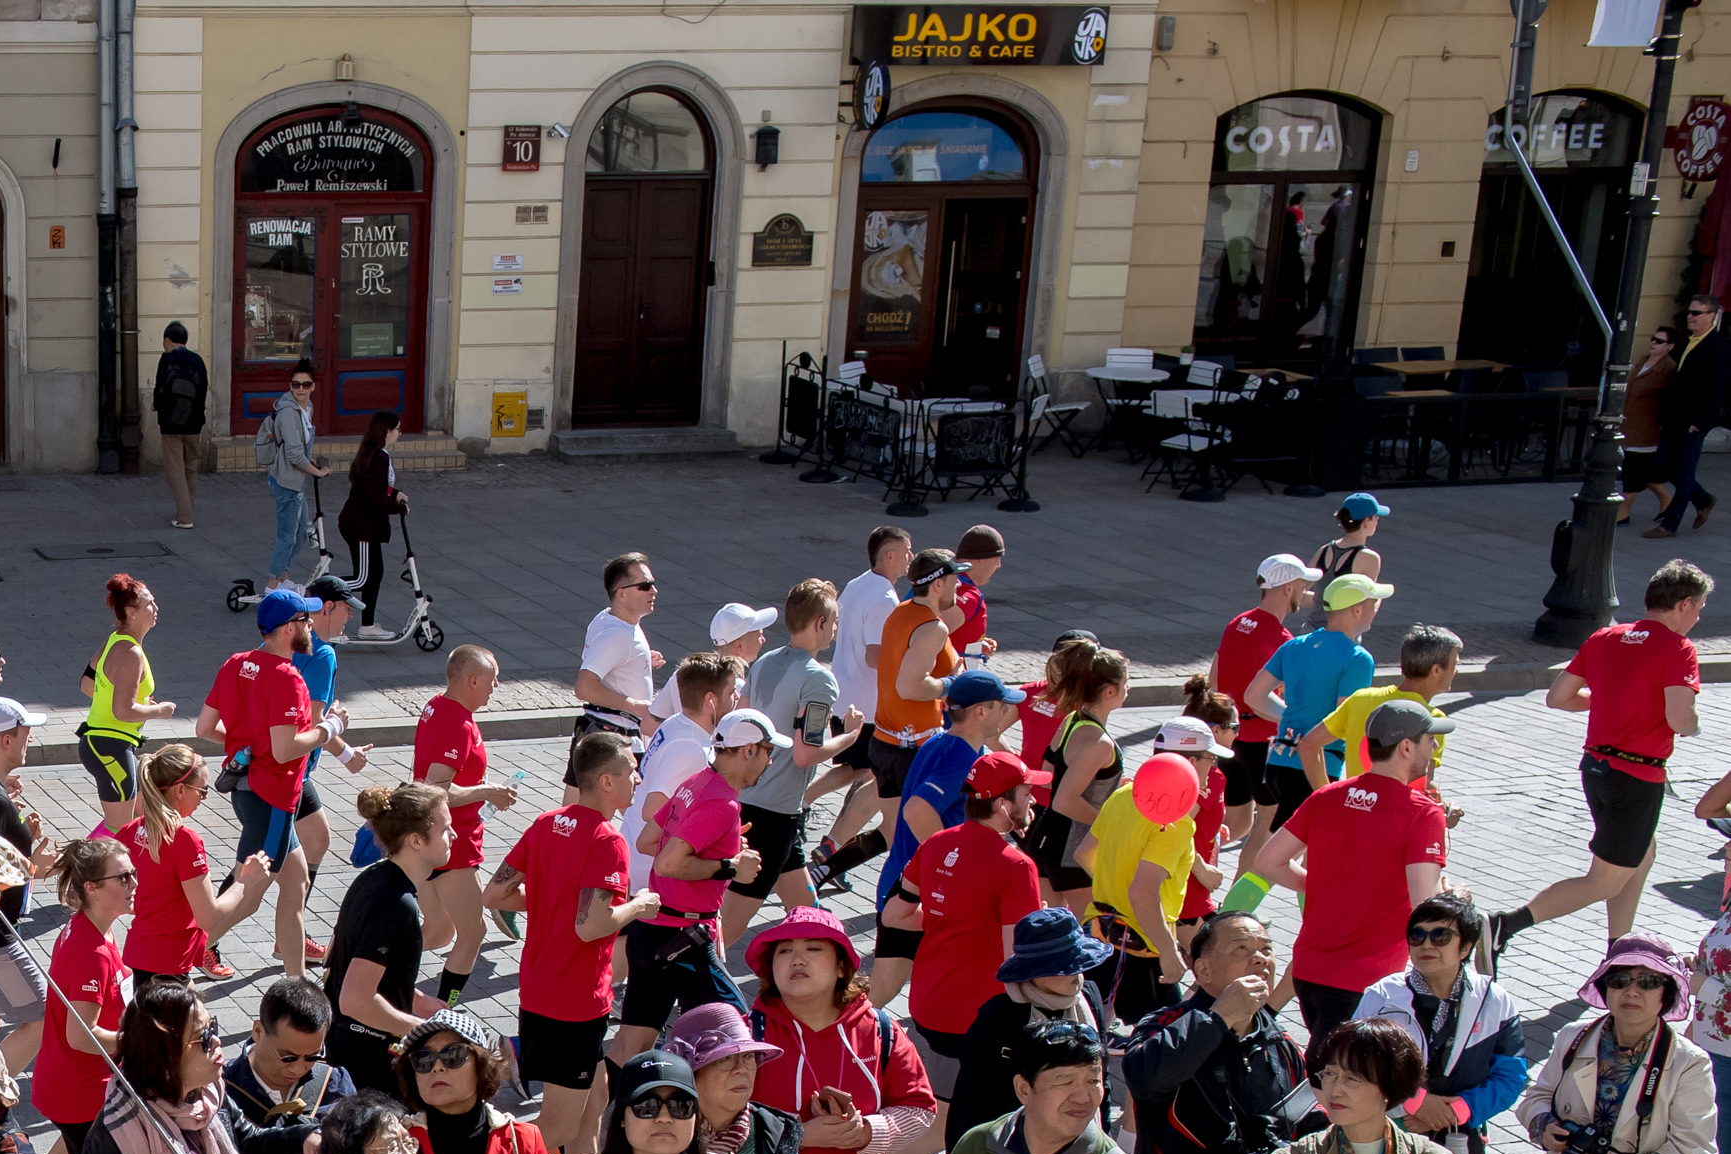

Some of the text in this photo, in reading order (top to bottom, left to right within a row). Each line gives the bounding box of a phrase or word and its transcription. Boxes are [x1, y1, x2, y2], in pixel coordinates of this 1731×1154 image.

[893, 12, 1038, 42] JAJKO
[891, 44, 1034, 58] BISTRO & CAFE
[1687, 104, 1726, 129] COSTA
[256, 120, 416, 158] PRACOWNIA ARTYCZNYCH
[287, 136, 386, 156] RAM STYLOWYCH
[1226, 124, 1336, 156] COSTA
[1484, 124, 1605, 150] COFFEE
[512, 141, 533, 162] 10
[1677, 149, 1723, 178] COFFEE
[276, 179, 388, 192] Paweł Remiszewski
[250, 220, 311, 235] RENOWACJA
[354, 226, 396, 242] RAMY
[269, 233, 292, 246] RAM
[341, 242, 408, 258] STYLOWE
[917, 567, 944, 585] SPORT
[1267, 566, 1298, 583] NIKE
[1622, 630, 1650, 642] 100
[1345, 787, 1378, 809] 100
[553, 814, 577, 834] 100
[1645, 1067, 1659, 1096] Canon
